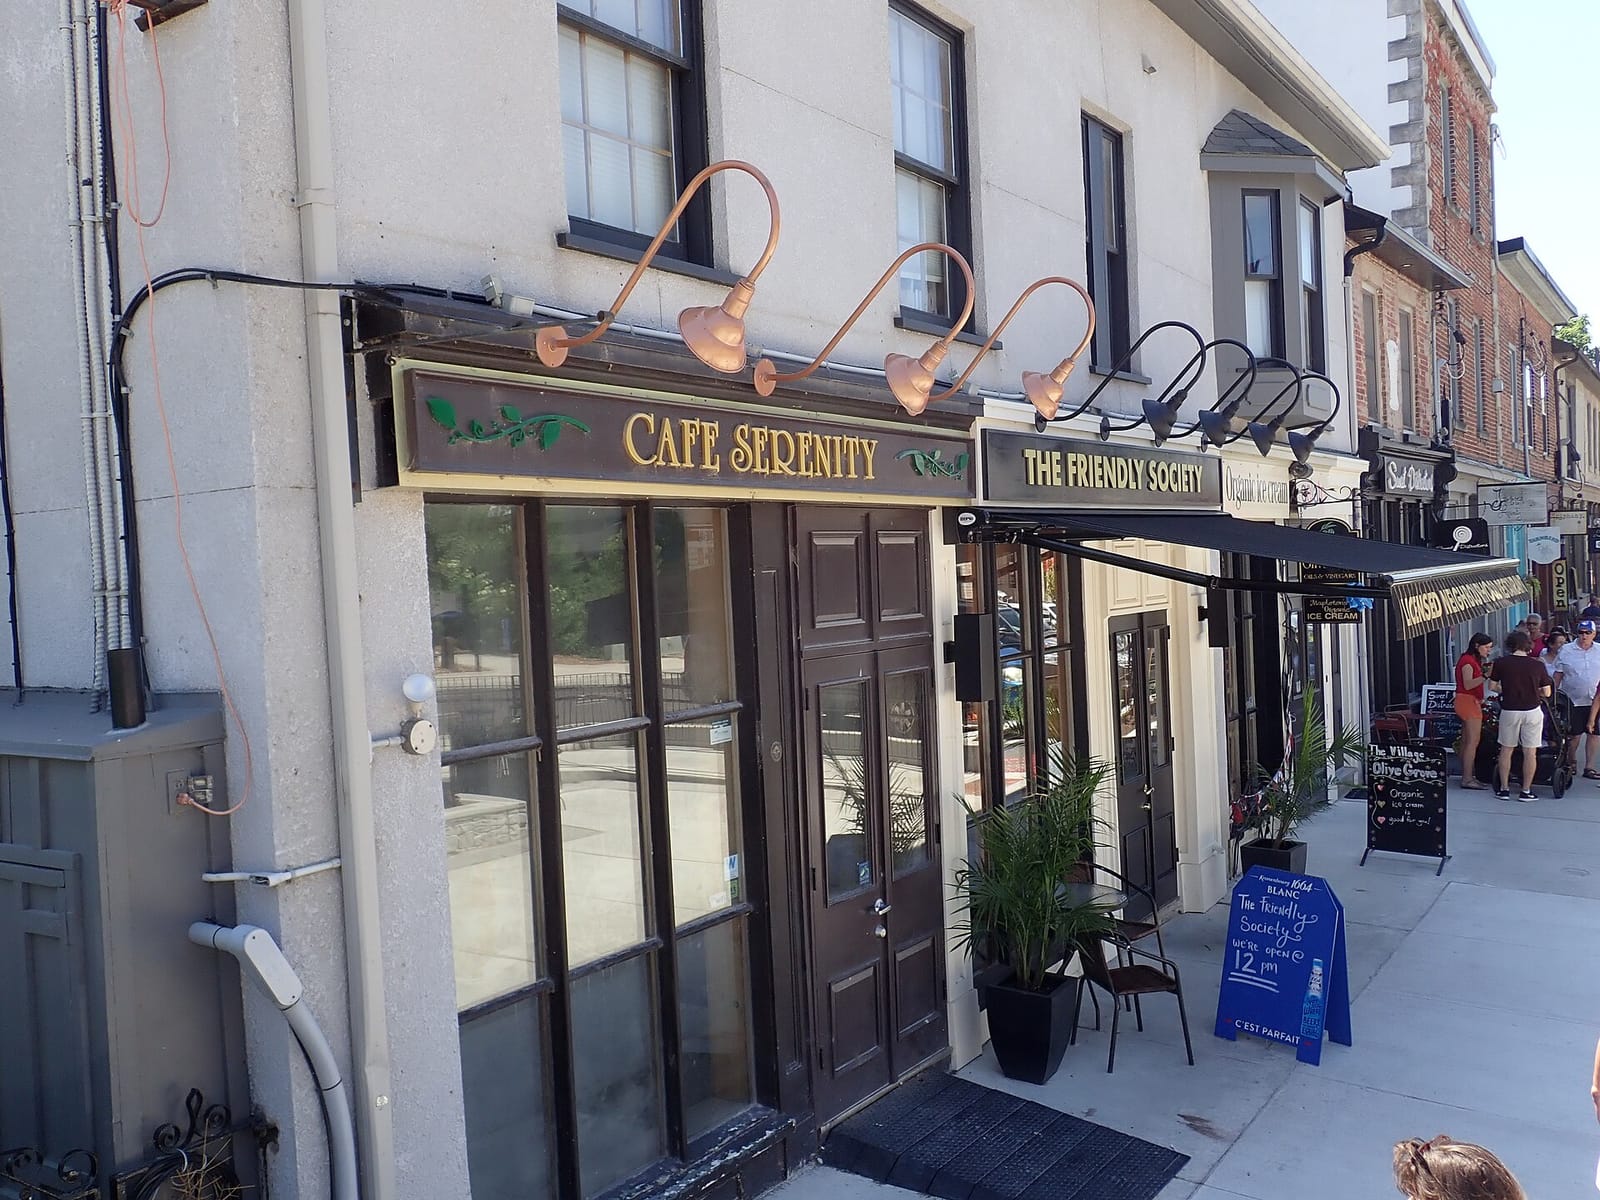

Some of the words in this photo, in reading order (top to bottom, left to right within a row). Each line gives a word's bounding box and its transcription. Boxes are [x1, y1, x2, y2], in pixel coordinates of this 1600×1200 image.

[622, 412, 720, 473] CAFE
[729, 422, 879, 480] SERENITY
[1023, 448, 1062, 487] THE
[1067, 452, 1145, 491] FRIENDLY
[1147, 461, 1203, 494] SOCIETY
[1226, 465, 1256, 511] Organic
[1267, 481, 1289, 504] cream
[1554, 562, 1566, 608] Open
[1307, 612, 1322, 620] ICE
[1324, 612, 1358, 620] CREAM
[1401, 591, 1443, 627] LICENSED
[1369, 744, 1387, 757] The
[1389, 745, 1425, 763] Village
[1372, 761, 1402, 777] Olive
[1403, 762, 1438, 778] Grove
[1390, 788, 1425, 801] Organic
[1267, 885, 1301, 900] BLANC
[1291, 879, 1314, 893] 1664
[1240, 915, 1303, 948] Society
[1234, 949, 1257, 974] 12
[1260, 961, 1279, 976] pm
[1235, 1019, 1260, 1033] C'EST
[1262, 1027, 1301, 1045] PARFAIT
